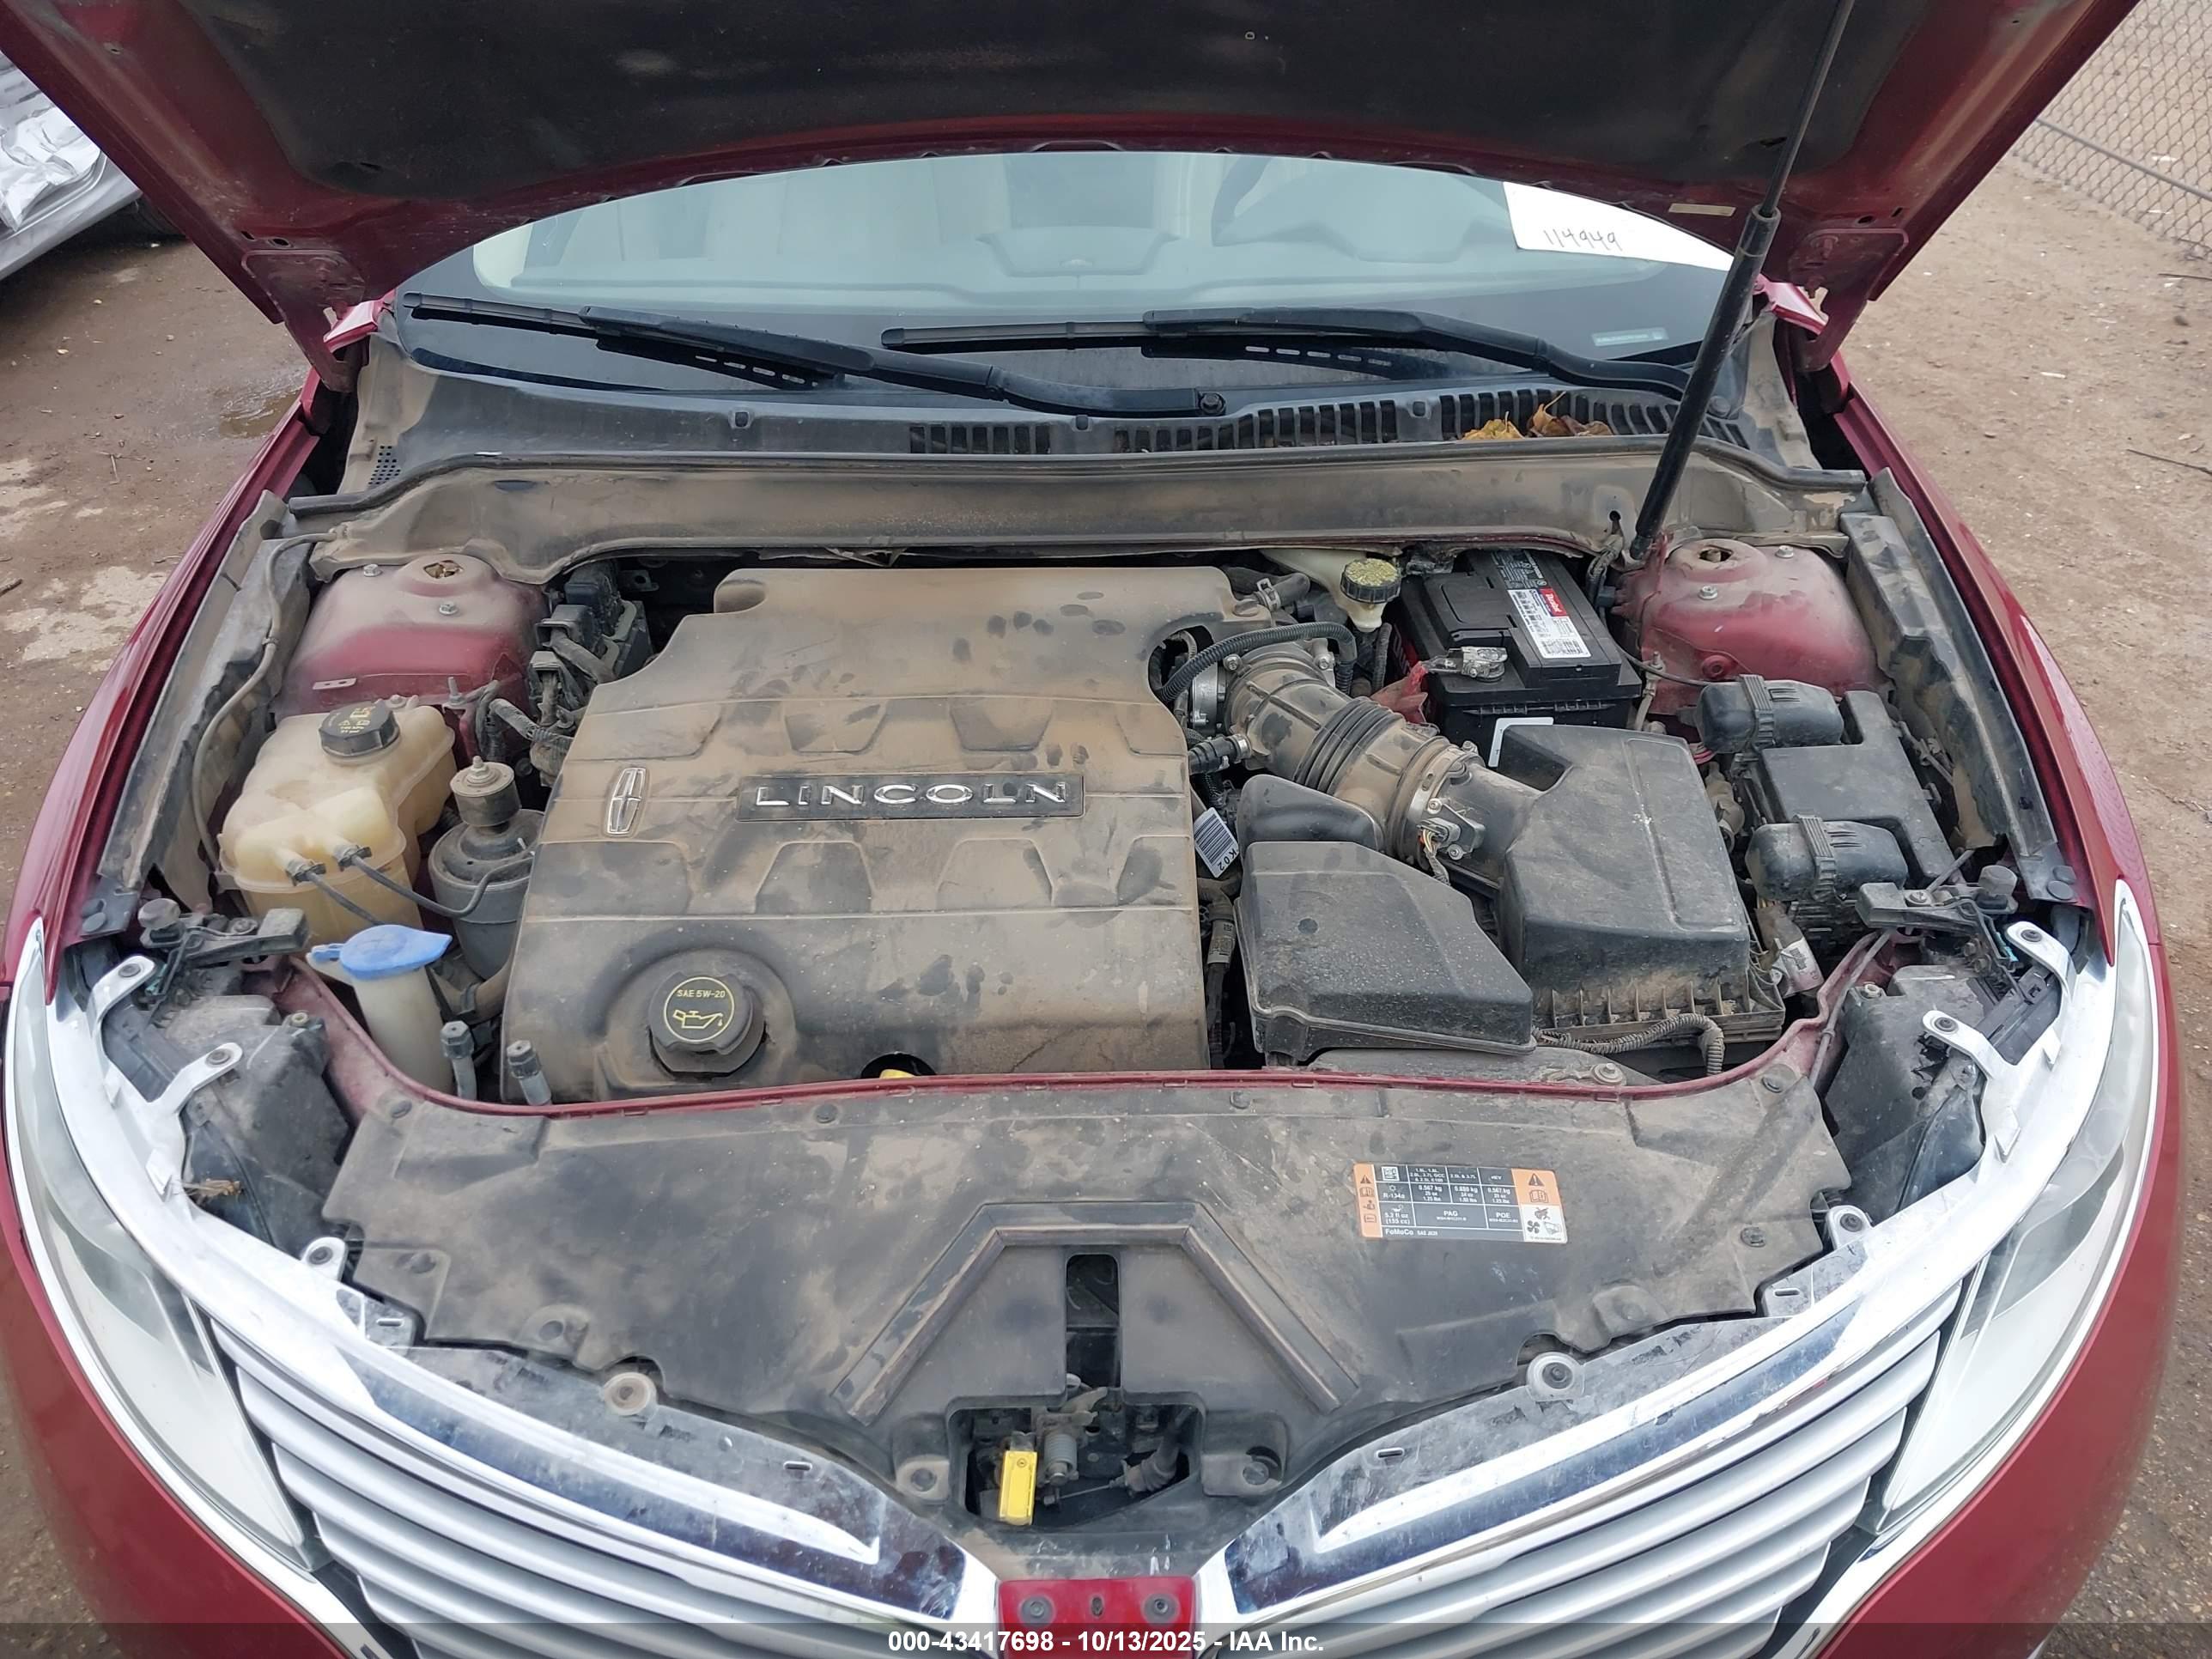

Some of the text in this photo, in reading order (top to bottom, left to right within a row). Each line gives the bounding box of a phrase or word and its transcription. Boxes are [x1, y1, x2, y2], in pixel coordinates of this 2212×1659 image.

[1543, 228, 1622, 252] 114949
[756, 782, 1066, 806] LINCOLN
[1218, 848, 1237, 872] K02
[677, 989, 726, 999] SAE 5W-20
[1434, 1184, 1443, 1193] kg
